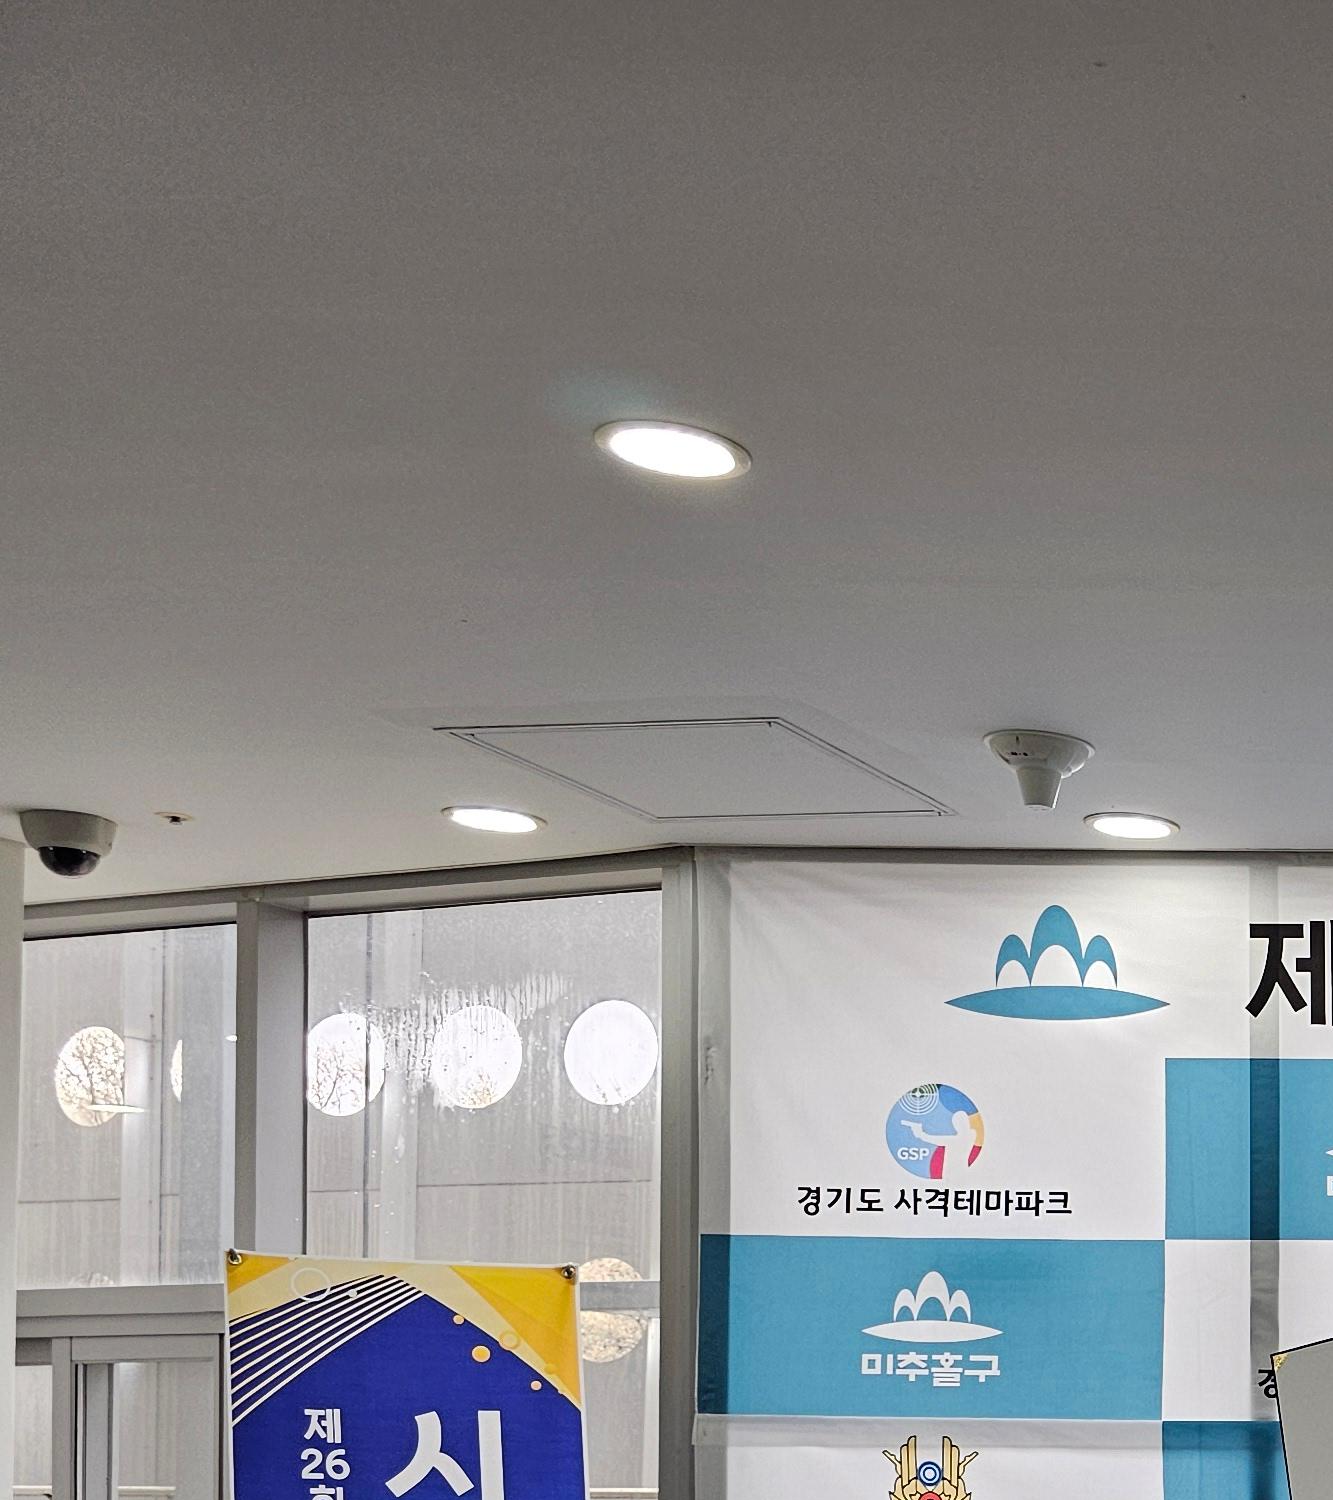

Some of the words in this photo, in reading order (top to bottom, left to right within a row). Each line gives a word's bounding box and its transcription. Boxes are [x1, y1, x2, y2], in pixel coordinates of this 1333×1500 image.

[897, 1148, 929, 1160] GSP
[798, 1187, 883, 1215] 경기도
[895, 1189, 1072, 1217] 사격테마파크
[862, 1352, 1000, 1386] 미추홀구
